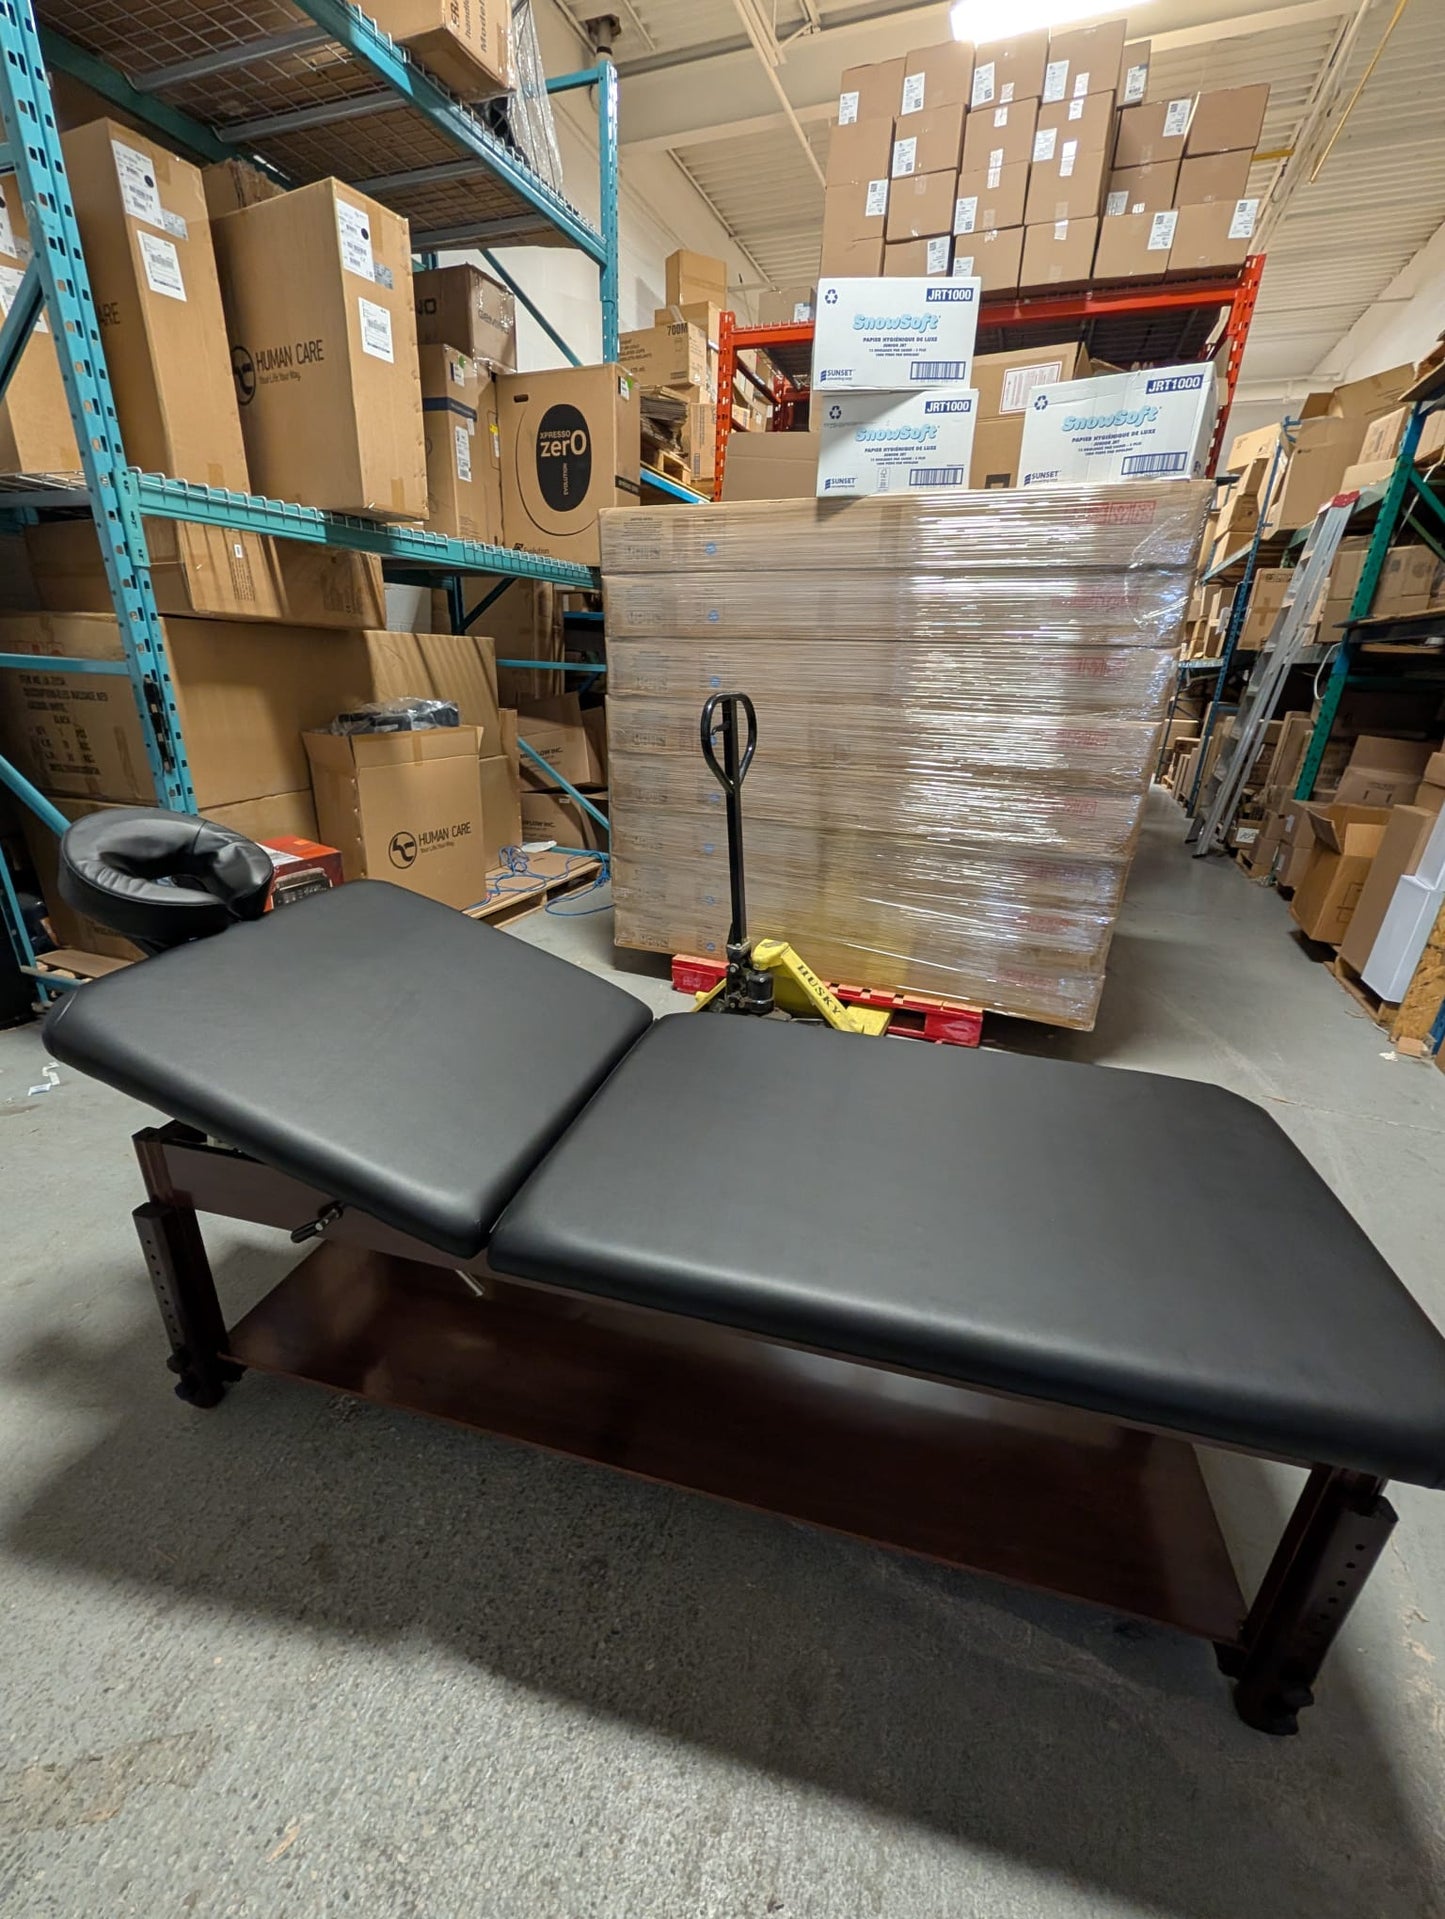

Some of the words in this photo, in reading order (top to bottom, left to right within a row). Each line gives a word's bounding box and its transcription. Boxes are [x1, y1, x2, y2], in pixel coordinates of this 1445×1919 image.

[927, 289, 972, 301] JRT1000
[853, 312, 939, 333] SnowSoft
[255, 346, 293, 372] HUMAN
[295, 339, 325, 365] CARE
[827, 369, 853, 377] SUNSET
[1148, 376, 1200, 393] JRT1000
[926, 401, 969, 412] JRT1000
[1062, 404, 1159, 432] SnowSoft
[540, 430, 571, 438] XPRESSO
[855, 423, 939, 443] SnowSoft
[1032, 470, 1059, 480] SUNSET
[418, 827, 450, 846] HUMAN
[451, 821, 472, 838] CARE
[797, 964, 841, 1014] HUSKY
